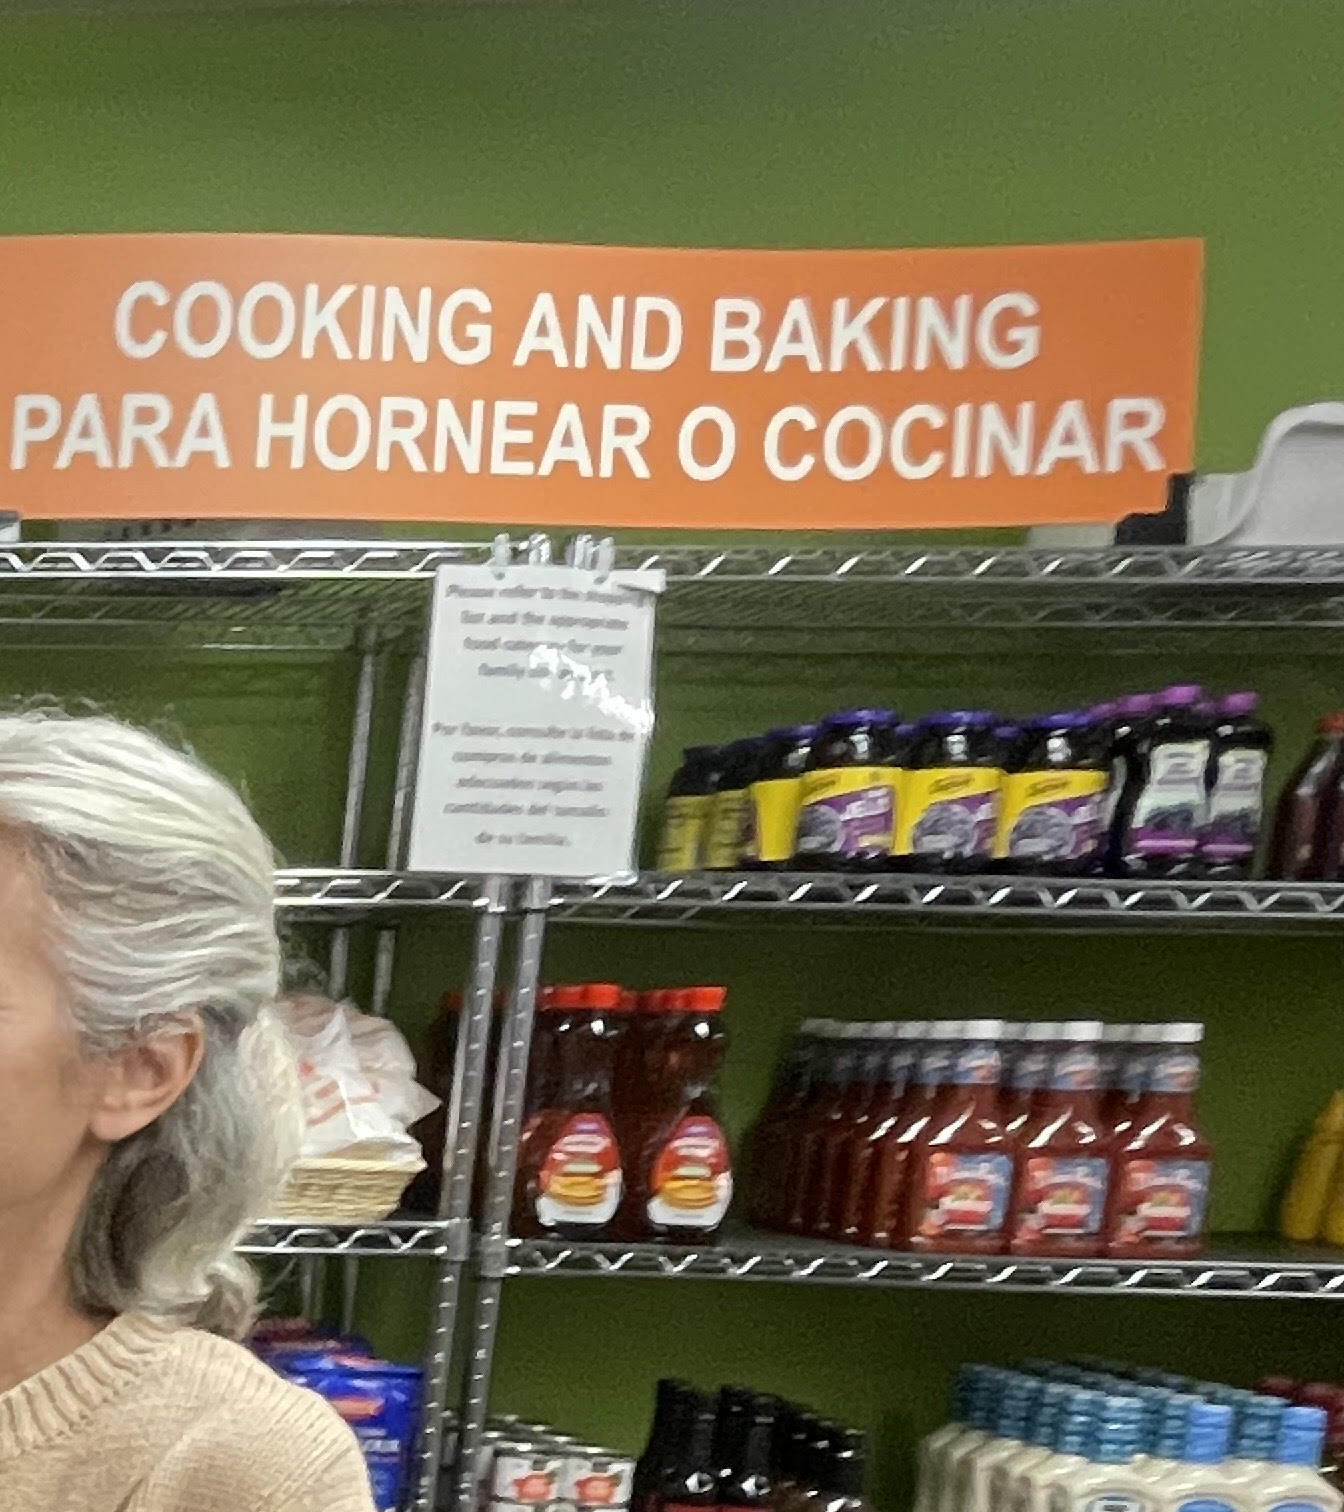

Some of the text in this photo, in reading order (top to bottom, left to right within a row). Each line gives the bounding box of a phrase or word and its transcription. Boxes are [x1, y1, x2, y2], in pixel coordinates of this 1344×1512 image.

[114, 280, 1040, 375] COOKING AND BAKING
[9, 393, 1166, 482] PARA HORNEAR O COCINAR
